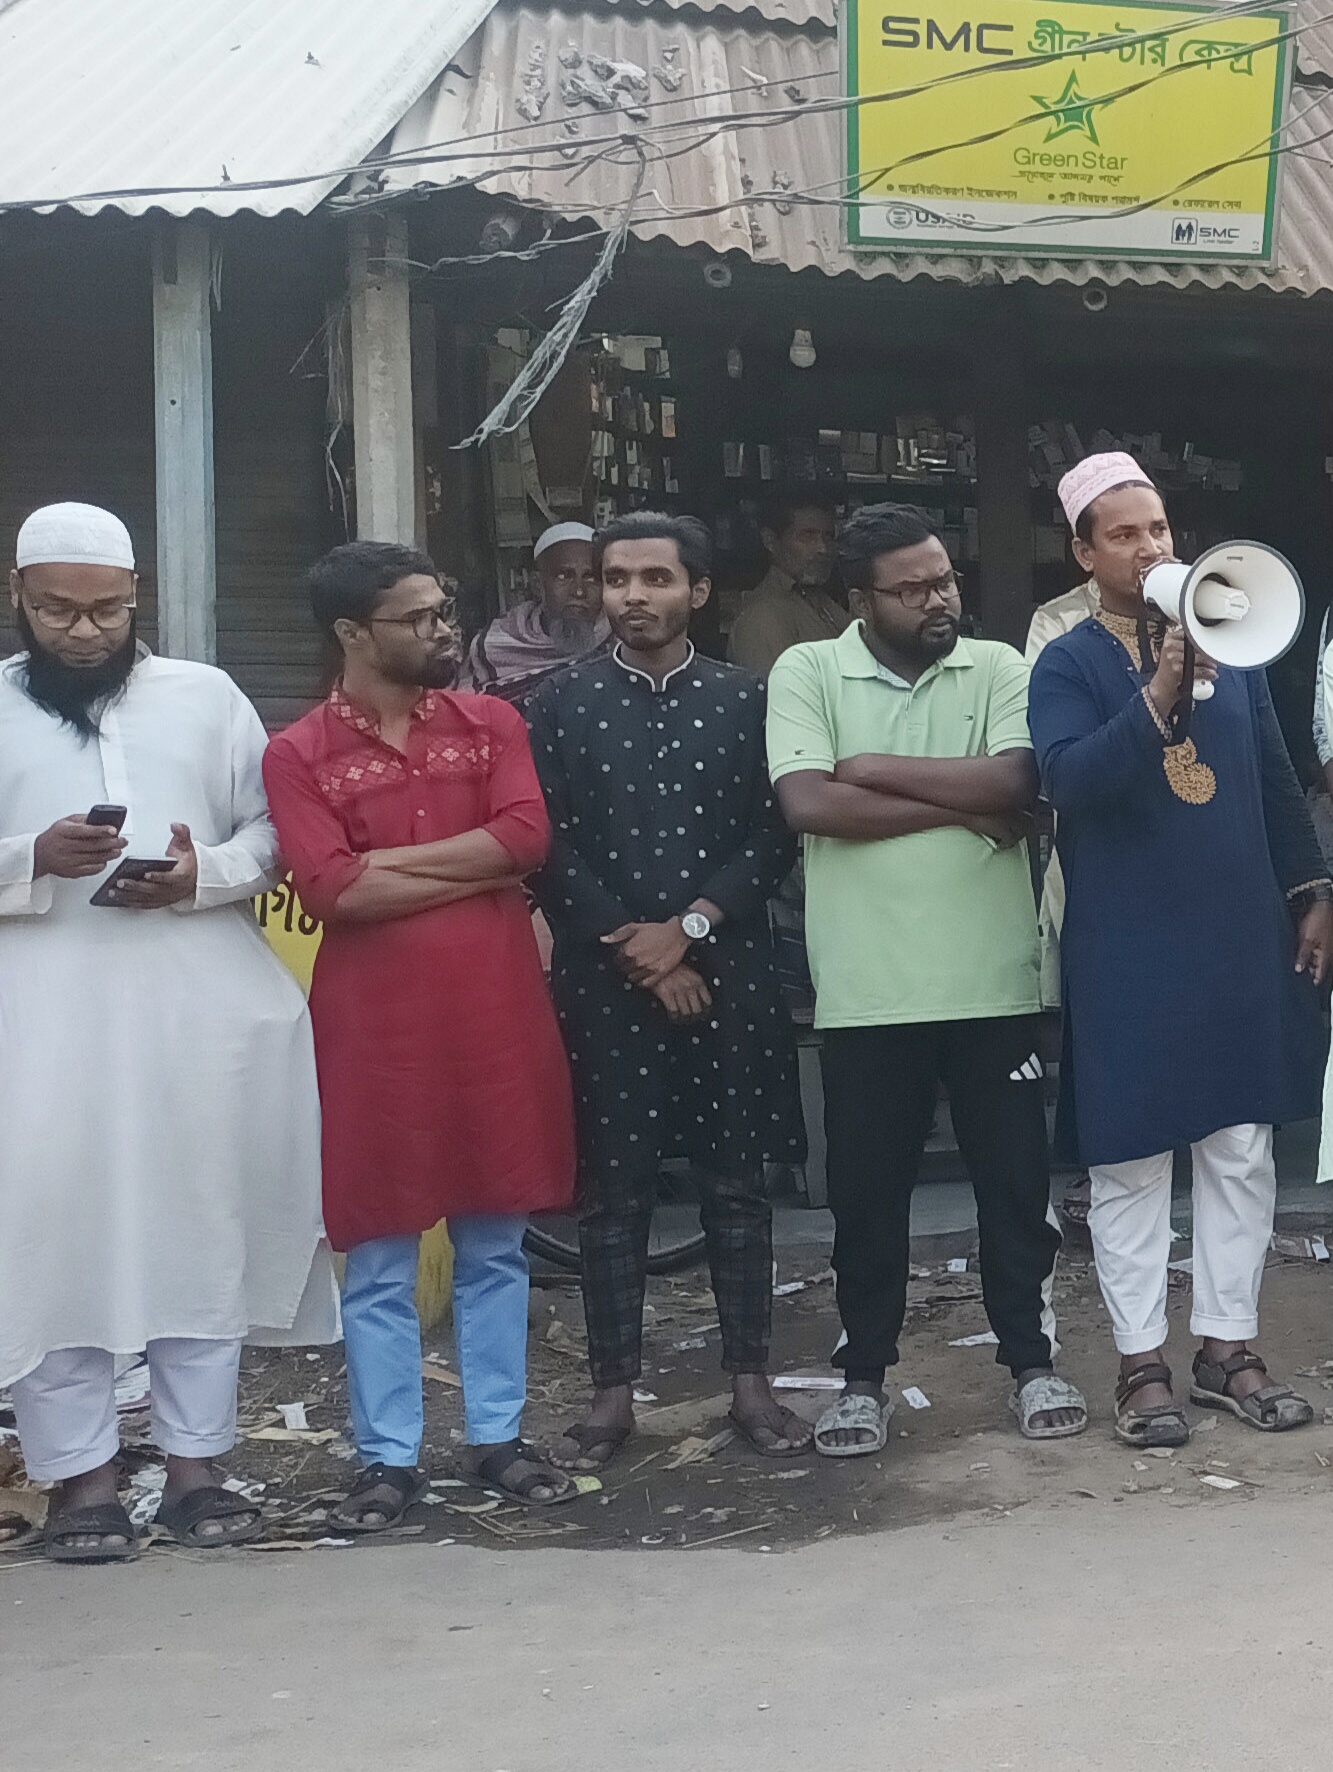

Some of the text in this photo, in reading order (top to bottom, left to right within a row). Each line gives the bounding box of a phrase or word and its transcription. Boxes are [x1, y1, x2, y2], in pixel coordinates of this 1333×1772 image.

[881, 15, 1014, 56] SMC
[915, 210, 976, 226] USID
[1199, 227, 1240, 239] SMC
